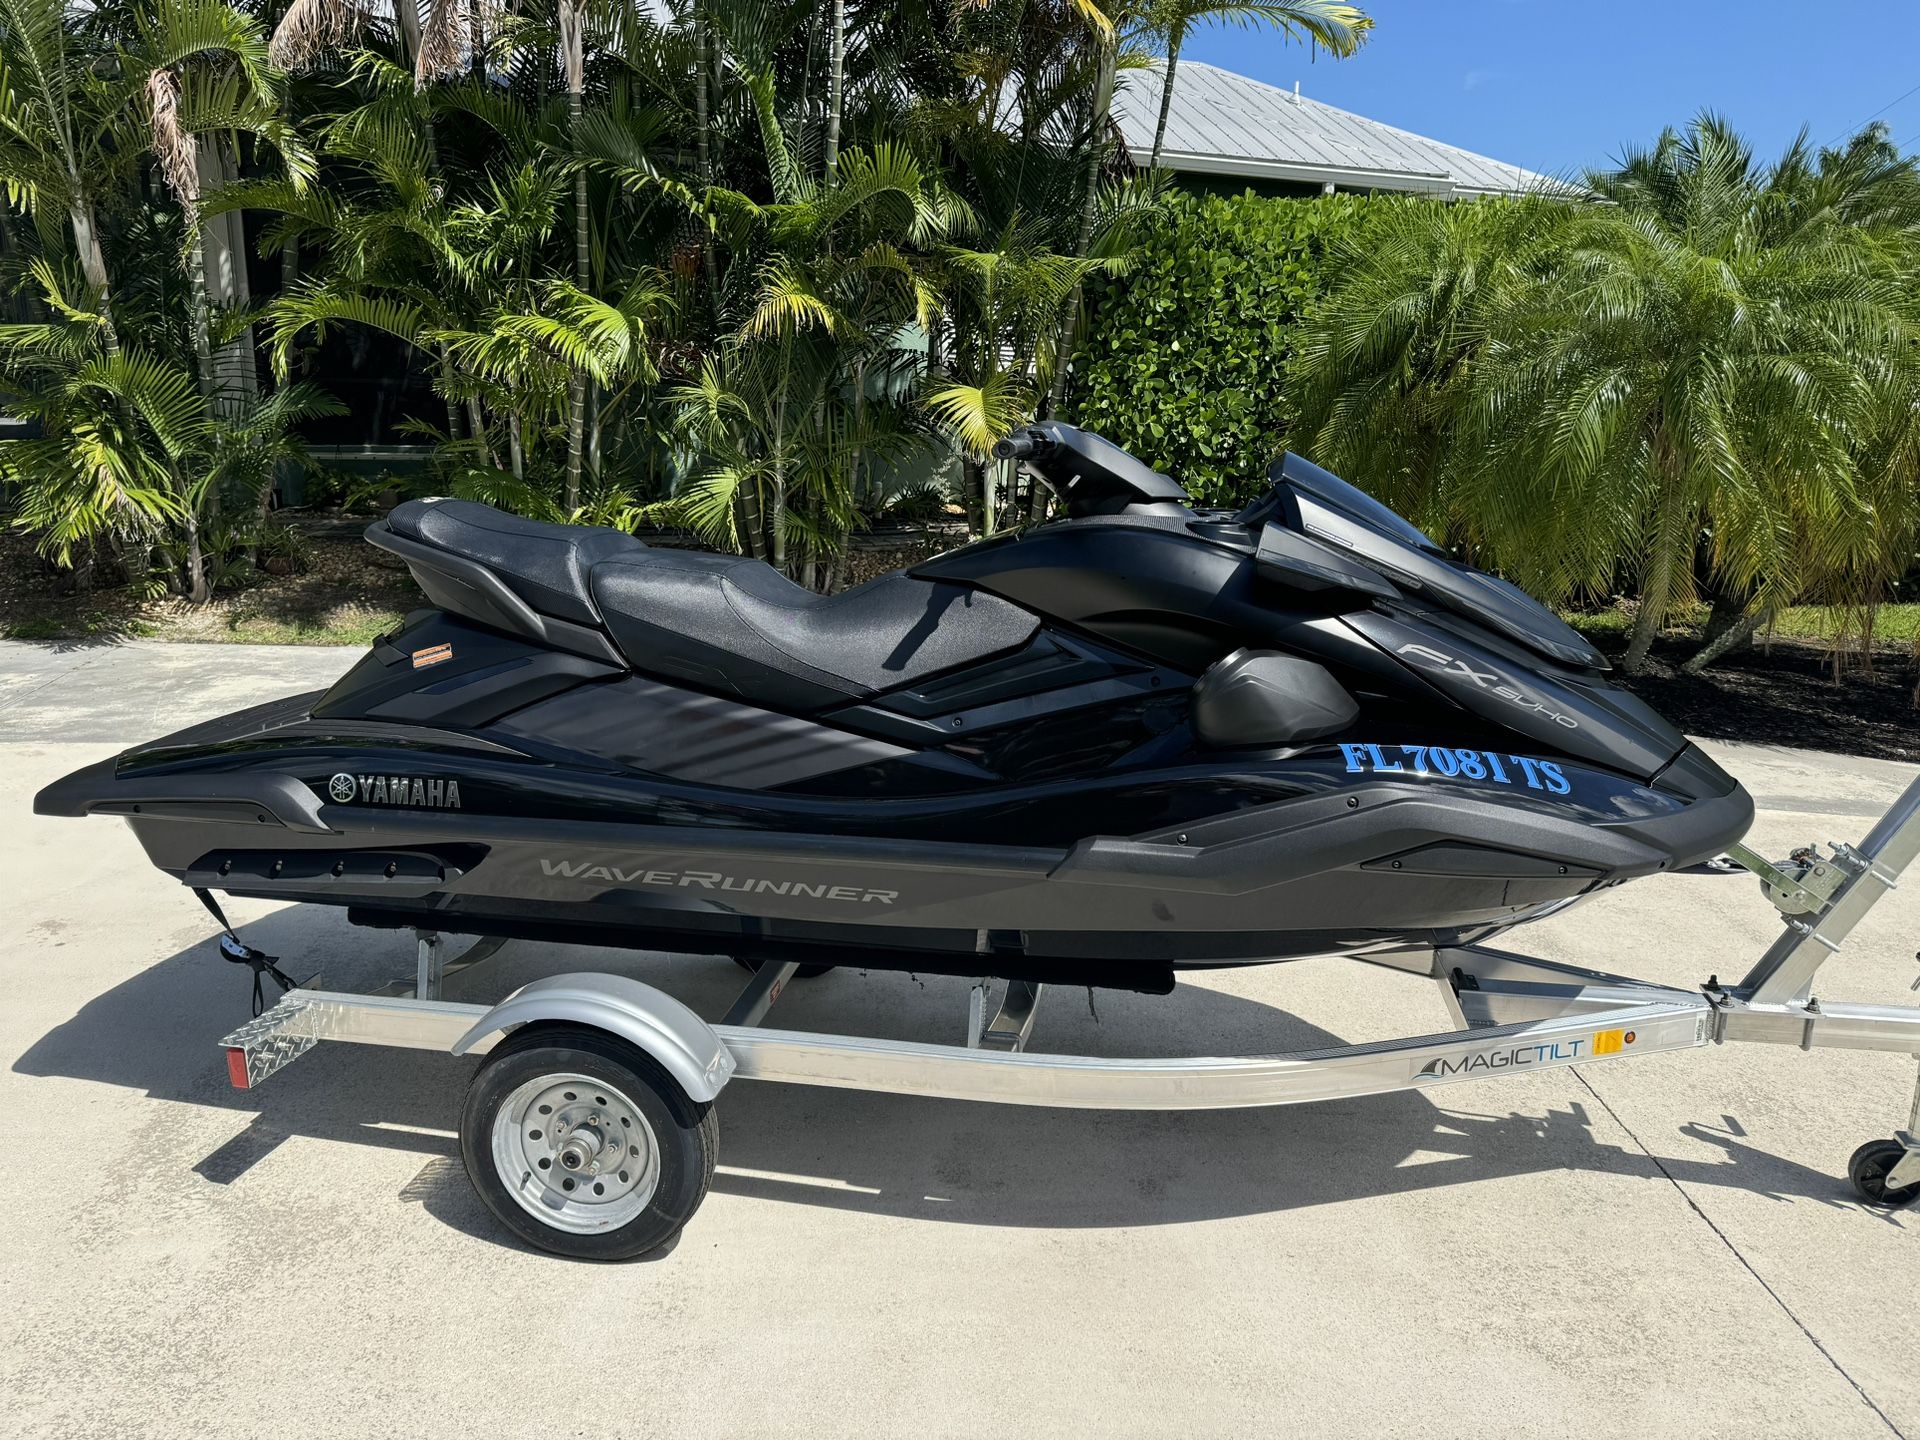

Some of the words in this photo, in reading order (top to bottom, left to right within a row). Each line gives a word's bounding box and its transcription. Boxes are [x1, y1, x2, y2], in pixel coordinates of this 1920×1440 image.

[1397, 643, 1499, 687] FX
[1491, 686, 1578, 729] SVHO
[358, 775, 461, 808] YAMAHA
[1337, 743, 1405, 773] FL
[1400, 744, 1511, 785] 7081
[1510, 755, 1571, 795] TS
[540, 858, 900, 905] WAVERUNNER
[1441, 1040, 1585, 1076] MAGICTILT
